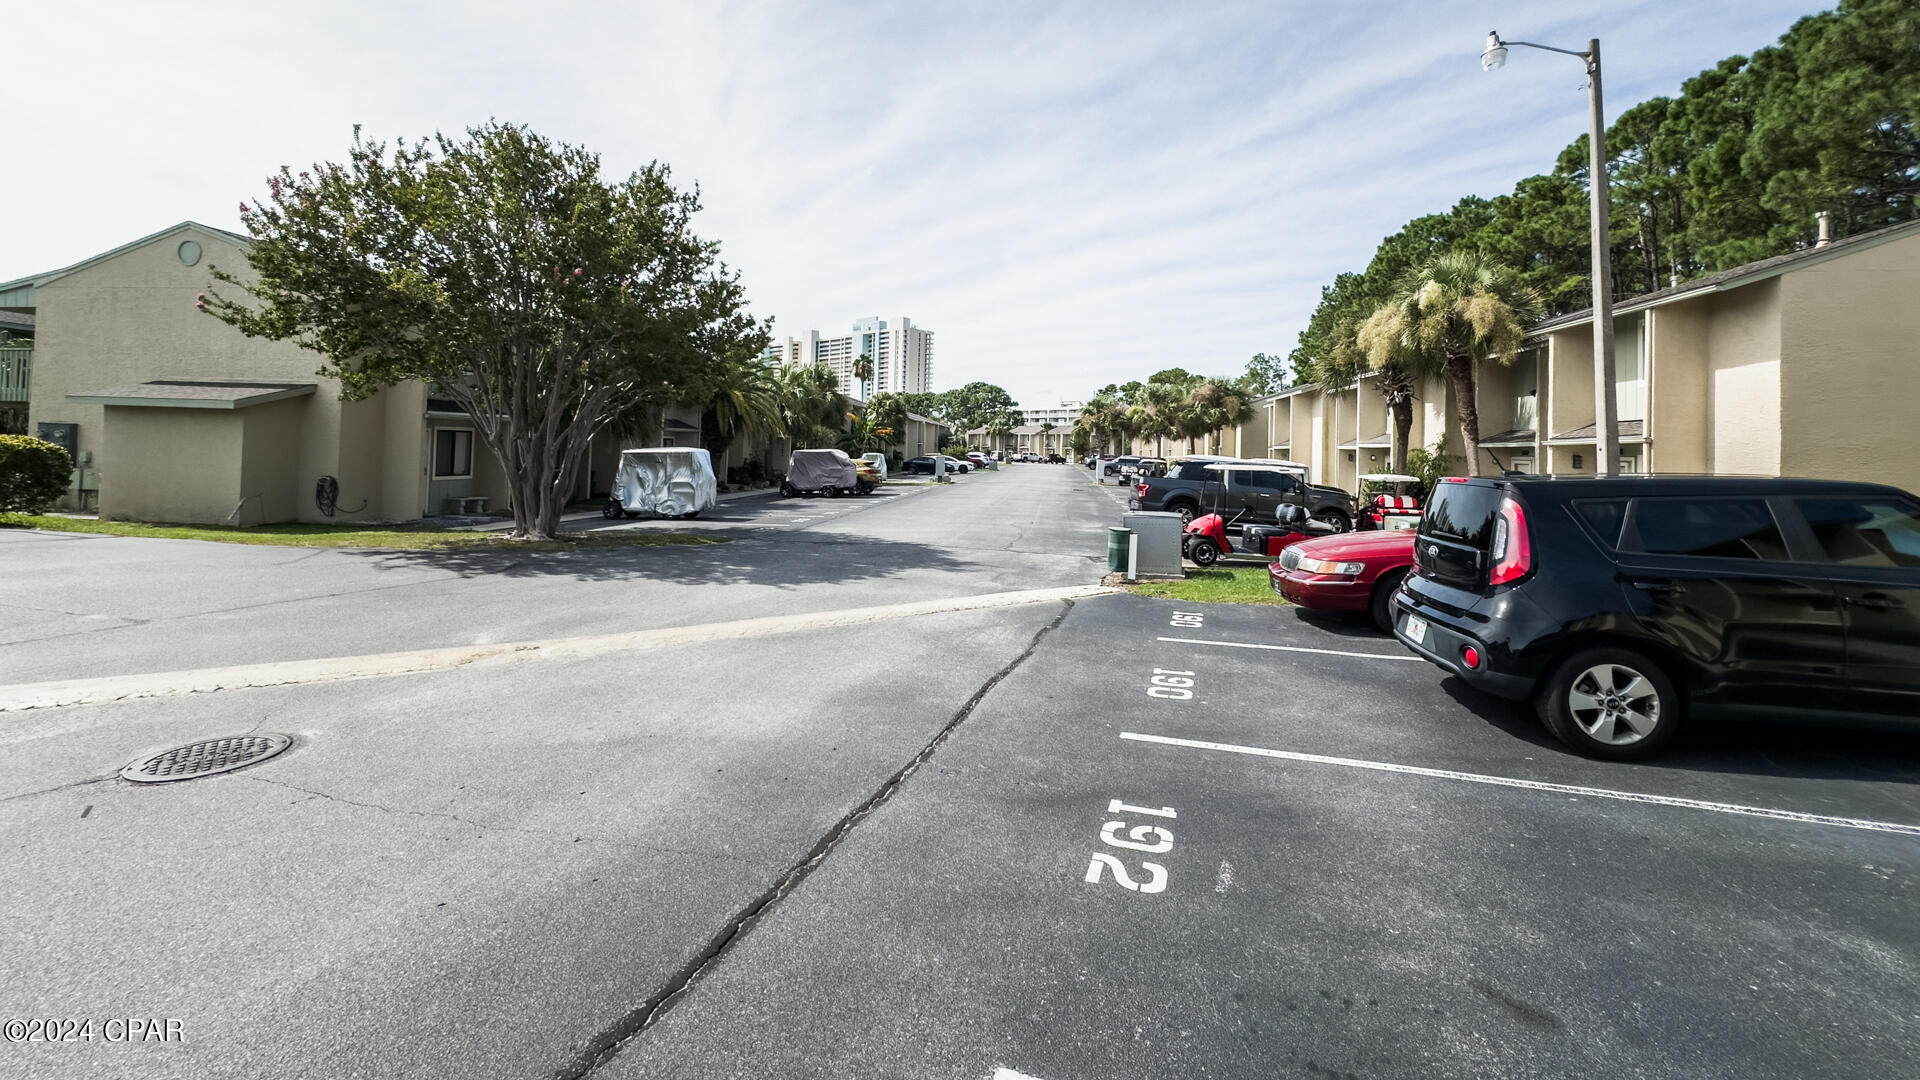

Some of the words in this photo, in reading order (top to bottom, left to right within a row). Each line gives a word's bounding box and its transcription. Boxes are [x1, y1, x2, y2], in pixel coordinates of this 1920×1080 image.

[1169, 611, 1204, 628] 190
[1146, 667, 1196, 700] 190
[1085, 799, 1178, 894] 192
